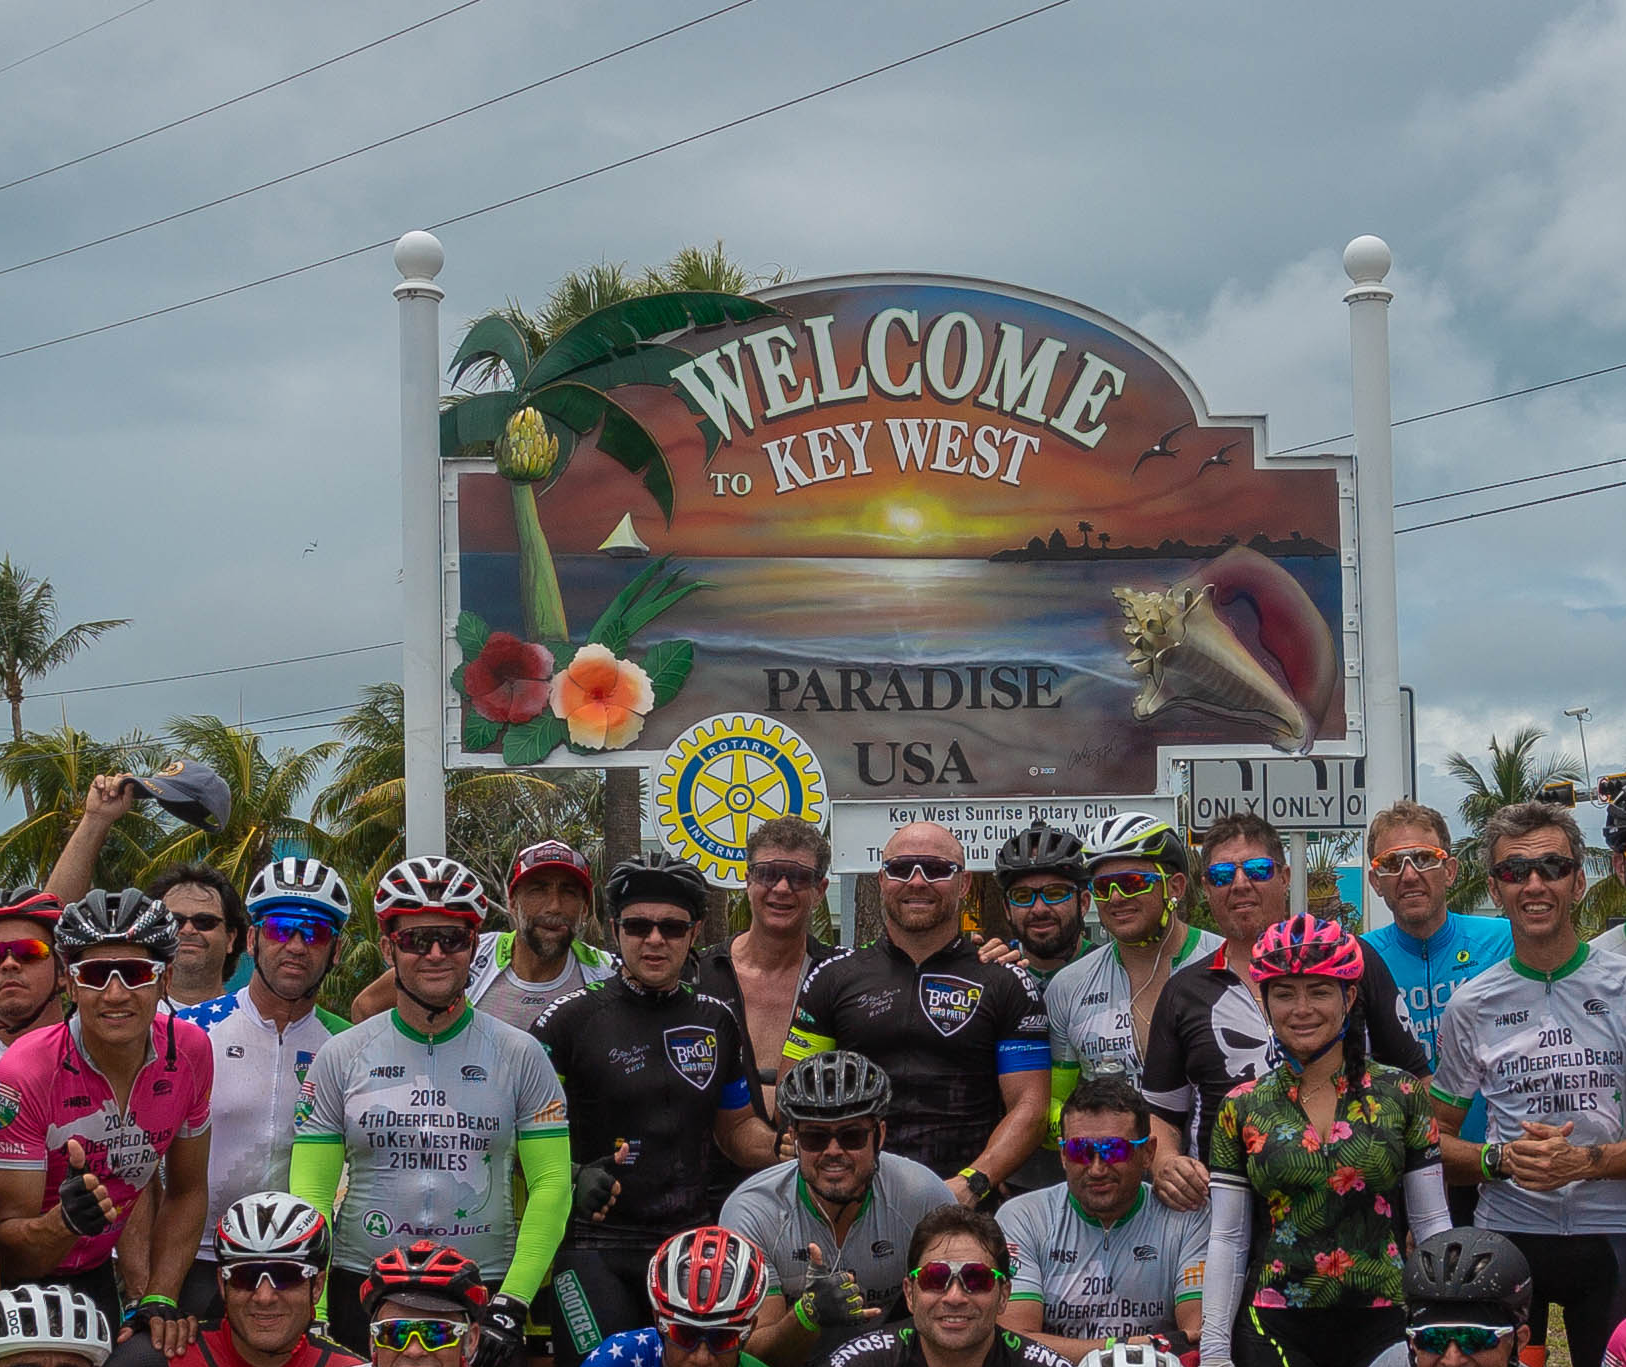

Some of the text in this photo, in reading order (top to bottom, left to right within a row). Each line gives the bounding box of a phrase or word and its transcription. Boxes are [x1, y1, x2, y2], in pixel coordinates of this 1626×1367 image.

[670, 308, 1127, 449] WELCOME
[710, 418, 1040, 496] TO KEY WEST
[762, 665, 1063, 713] PARADISE
[708, 739, 773, 757] ROTARY
[851, 738, 979, 786] USA
[889, 803, 1118, 823] Key West Sunrise Rotary Club
[1272, 796, 1335, 818] ONLY
[687, 823, 745, 859] INTERNA
[926, 988, 972, 1008] BROU
[946, 1009, 966, 1021] PRETO
[1494, 1010, 1530, 1028] #NQSF
[1537, 1028, 1573, 1048] 2018
[369, 1065, 406, 1079] #NQSF
[1497, 1048, 1624, 1078] 4TH DEERFIELD BEACH
[1523, 1069, 1616, 1094] KEY WEST RIDE
[410, 1088, 447, 1107] 2018
[1526, 1093, 1598, 1116] 215 MILES
[358, 1110, 501, 1132] 4TH DEERFIELD BEACH
[366, 1131, 491, 1151] TO KEY WEST RIDE
[389, 1151, 468, 1172] 215 MILES
[1081, 1276, 1113, 1296] 2018
[557, 1271, 594, 1335] SCOOTER
[1058, 1300, 1164, 1320] DEERFIELD BEACH
